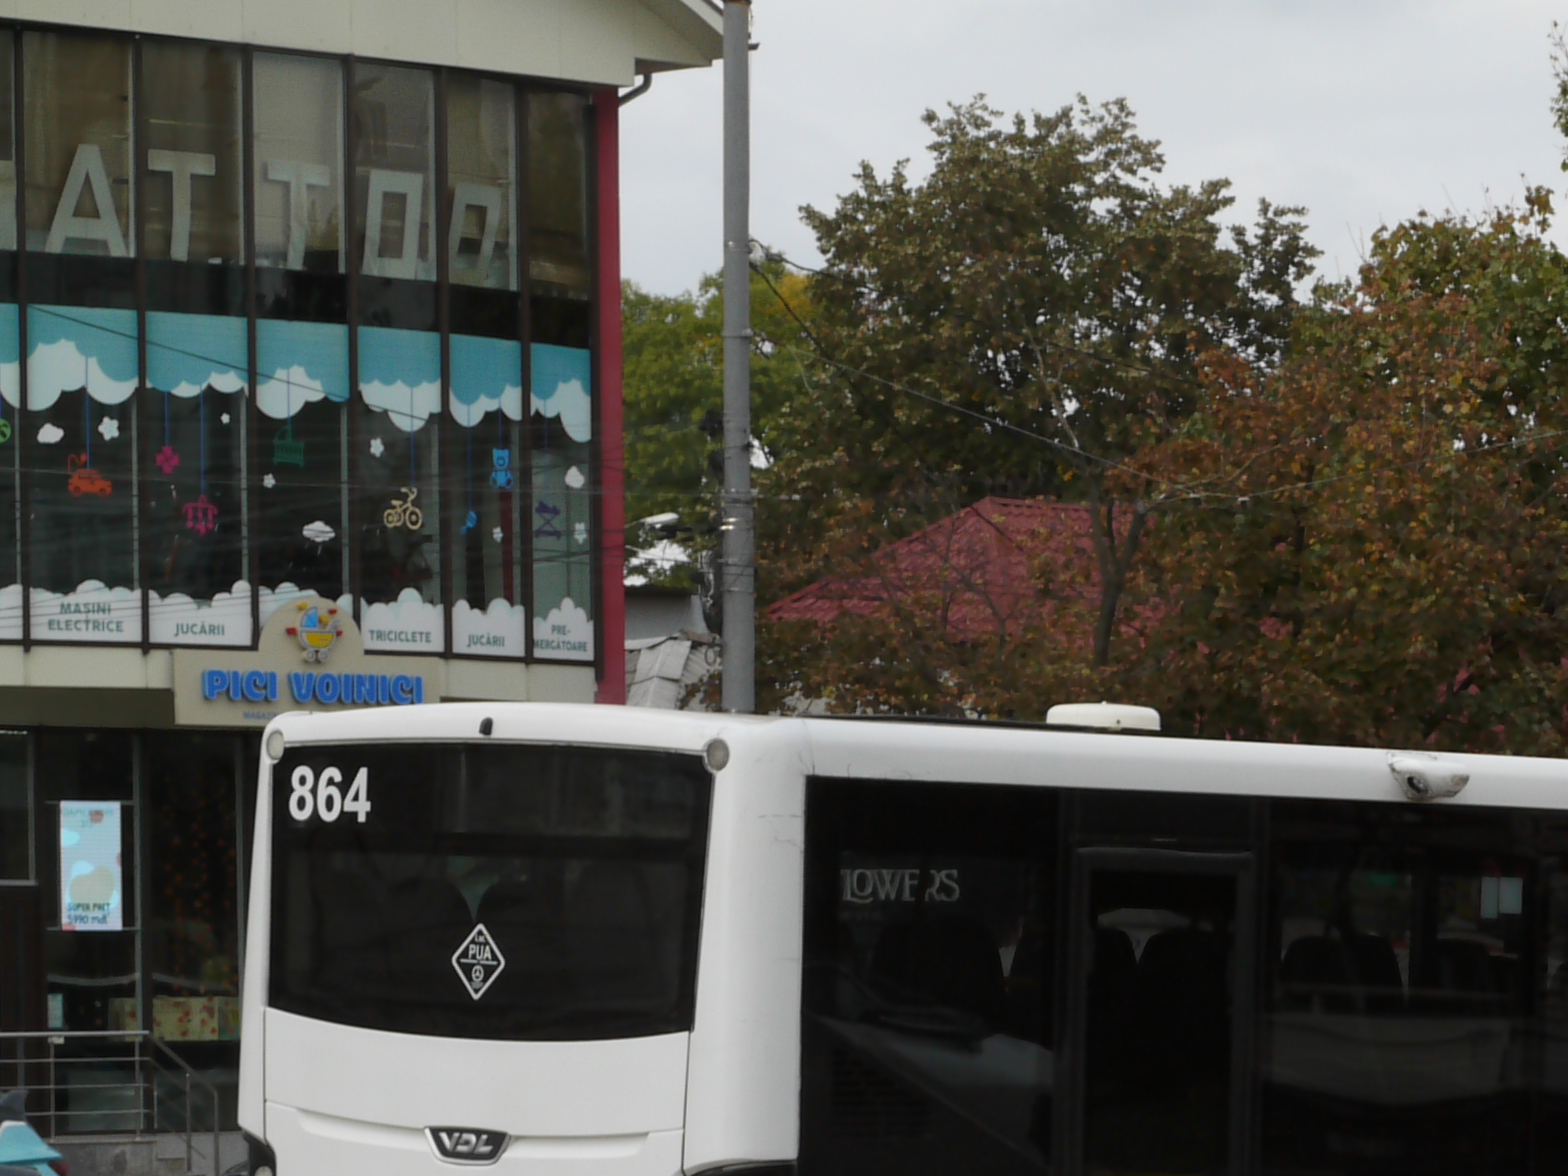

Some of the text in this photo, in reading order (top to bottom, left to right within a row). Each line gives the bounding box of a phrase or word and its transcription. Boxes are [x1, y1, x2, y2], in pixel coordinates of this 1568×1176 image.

[47, 618, 125, 633] ELECTRICE
[174, 621, 226, 637] JUCĂRII
[551, 624, 571, 636] PRE-
[368, 629, 432, 643] TRICICLETE
[466, 633, 505, 648] JUCĂRII
[203, 669, 424, 704] PICI VOINICI
[288, 764, 371, 823] 864
[468, 943, 492, 961] PUA
[438, 1130, 494, 1155] VDL
